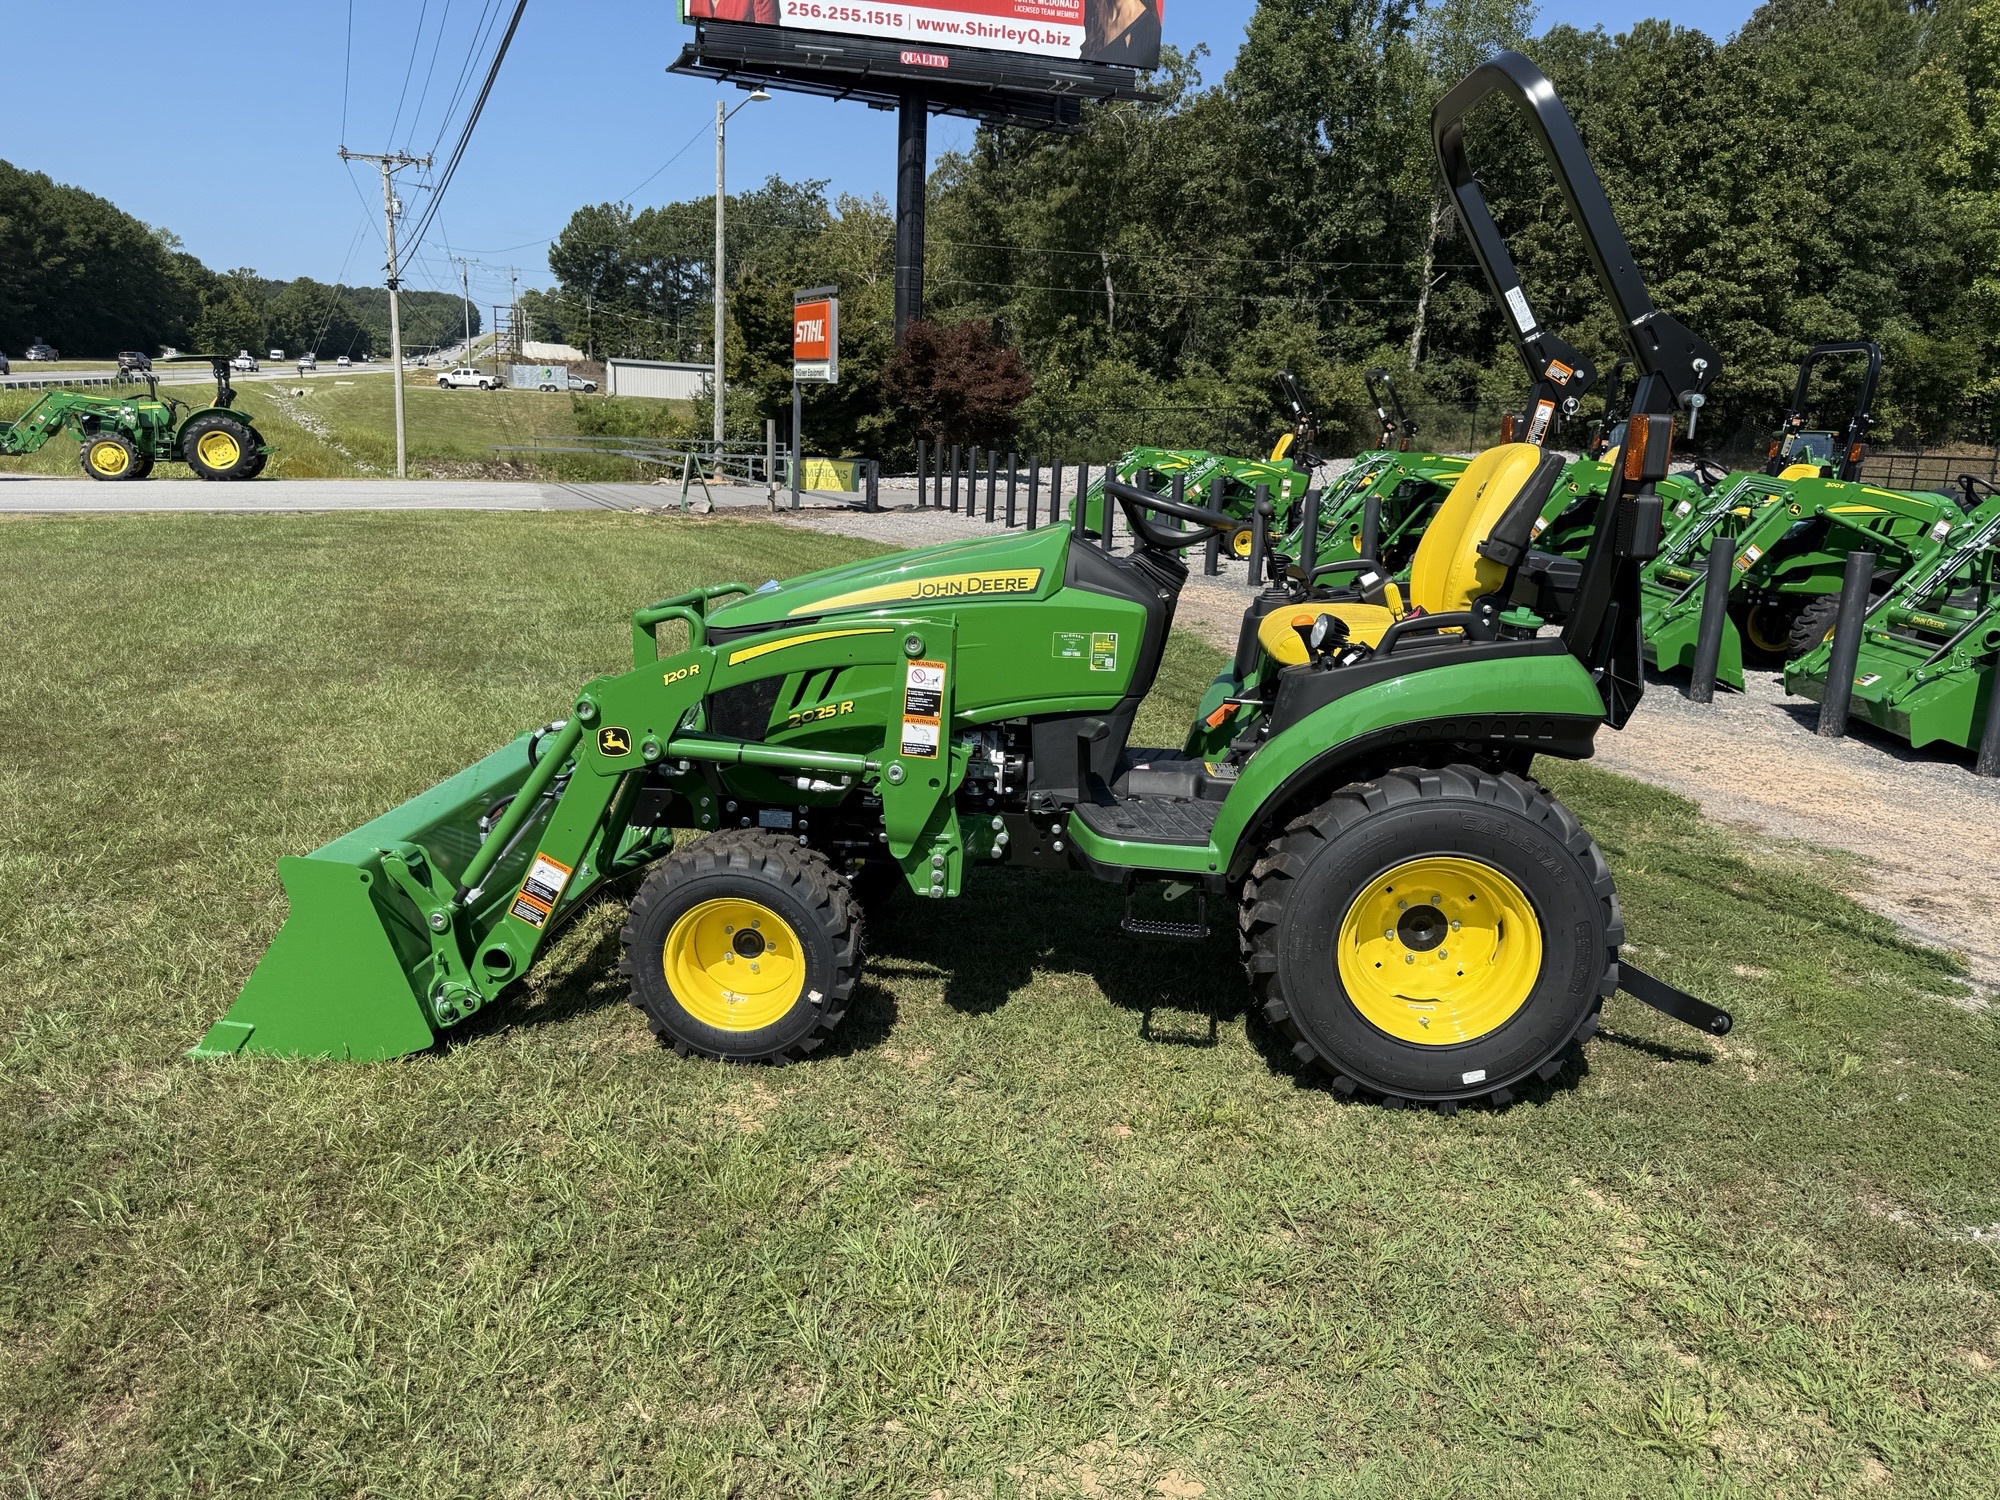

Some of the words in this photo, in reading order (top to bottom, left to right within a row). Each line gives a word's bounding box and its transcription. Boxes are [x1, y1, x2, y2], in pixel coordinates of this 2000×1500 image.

[1014, 5, 1040, 14] LICENSED
[1041, 8, 1056, 16] TEAM
[1056, 10, 1079, 19] MEMBER
[787, 2, 903, 27] 256.255.1515
[916, 18, 1071, 46] www.ShirleyQ.biz
[901, 52, 947, 67] QUALITY
[795, 319, 825, 343] STIHL
[911, 581, 962, 597] JOHN
[967, 578, 1029, 592] DEERE
[1911, 615, 1927, 625] JOHN
[1926, 618, 1947, 630] DEERE
[916, 660, 944, 669] WARNING
[663, 668, 688, 686] 120
[690, 664, 700, 676] R
[788, 704, 837, 729] 2025
[840, 700, 854, 714] R
[910, 718, 939, 726] WARNING
[547, 858, 568, 872] WARNING
